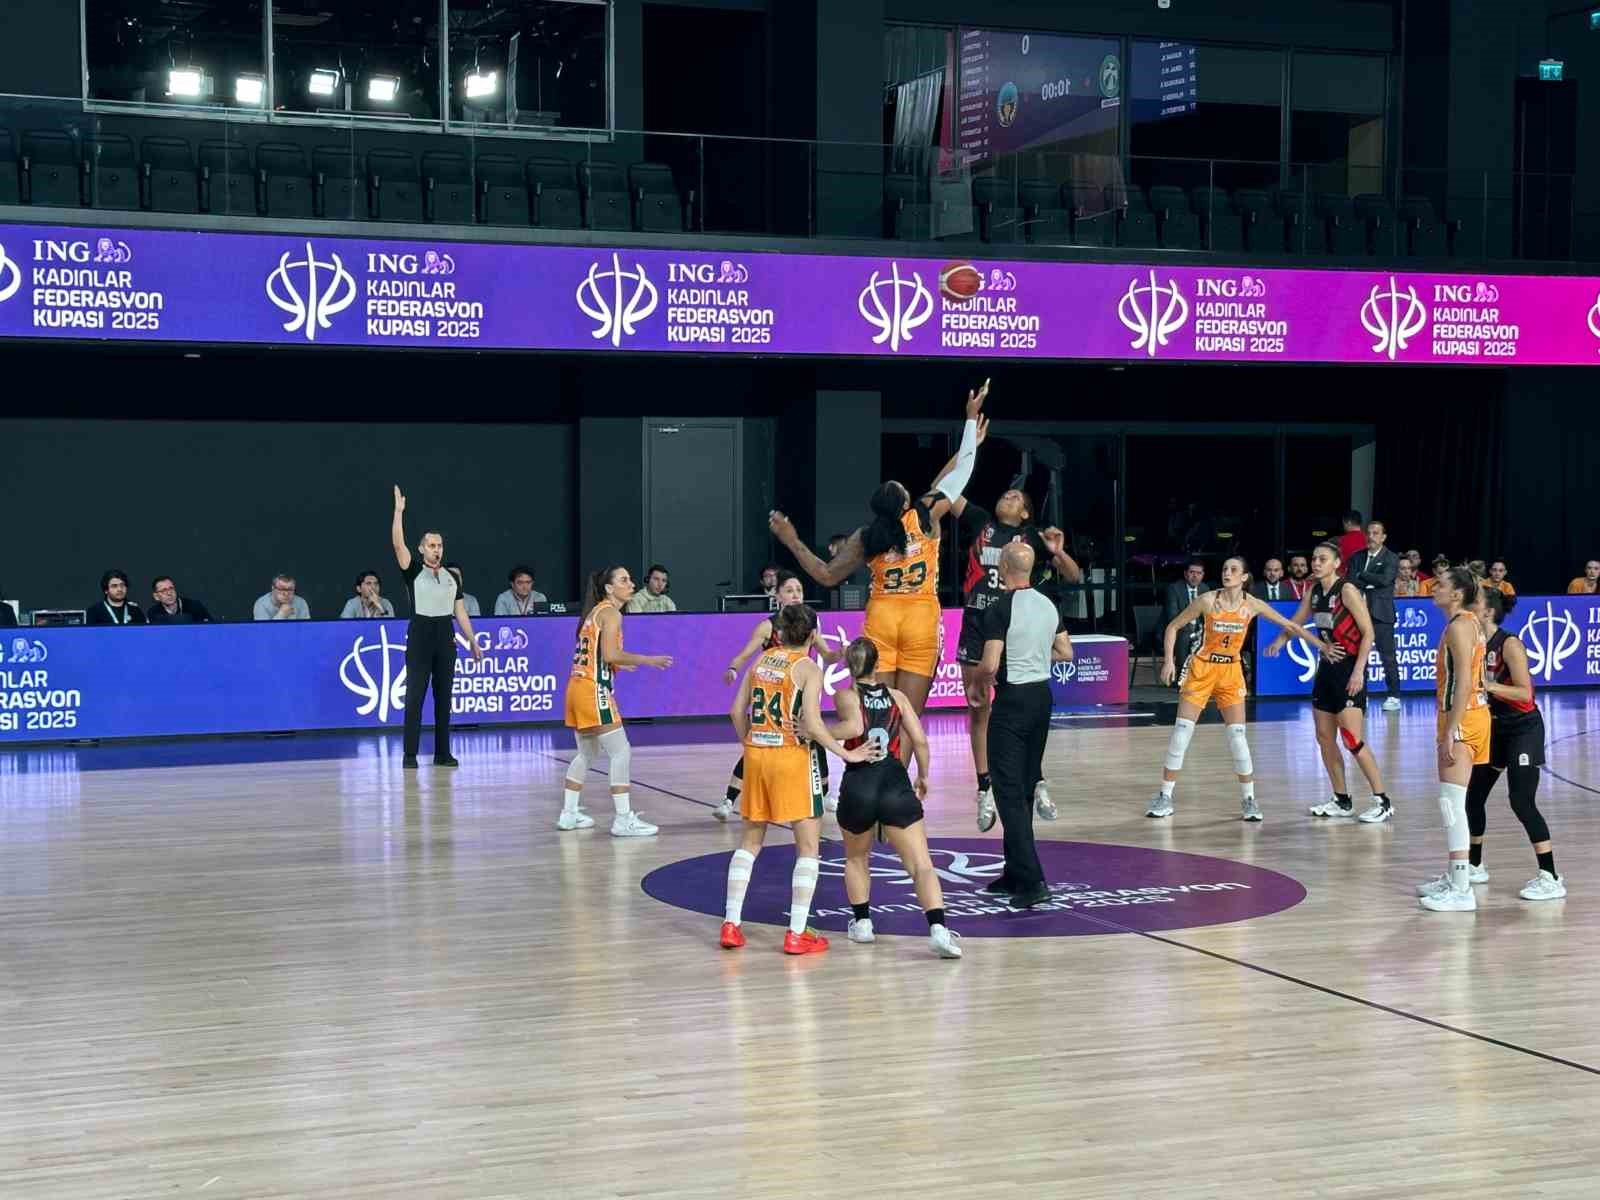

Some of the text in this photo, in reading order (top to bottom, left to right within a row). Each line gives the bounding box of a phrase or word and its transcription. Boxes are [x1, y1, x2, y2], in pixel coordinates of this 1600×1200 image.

[34, 240, 90, 262] ING
[368, 254, 418, 274] ING
[34, 268, 131, 288] KADINLAR
[669, 264, 714, 282] ING
[367, 280, 455, 298] KADINLAR
[1197, 279, 1237, 296] ING
[1435, 285, 1471, 302] ING
[34, 289, 162, 309] FEDERASYON
[668, 289, 748, 305] KADINLAR
[367, 300, 483, 318] FEDERASYON
[668, 308, 773, 324] FEDERASYON
[1196, 303, 1265, 317] KADINLAR
[1434, 308, 1498, 322] KADINLAR
[34, 309, 158, 329] KUPASI 2025
[942, 314, 1039, 330] FEDERASYON
[1196, 320, 1286, 335] FEDERASYON
[368, 319, 479, 337] KUPASI 2025
[668, 326, 770, 343] KUPASI 2025
[1433, 324, 1518, 339] FEDERASYON
[942, 332, 1036, 348] KUPASI 2025
[1196, 337, 1283, 352] KUPASI 2025
[1433, 341, 1515, 355] KUPASI 2025
[885, 561, 927, 590] 33
[454, 657, 528, 674] ADINLAR
[1412, 665, 1437, 680] 202
[452, 675, 556, 694] EDERASYON
[928, 681, 967, 697] 2025
[451, 694, 553, 714] UPASI 2025
[752, 687, 784, 728] 24
[27, 710, 77, 729] 2025
